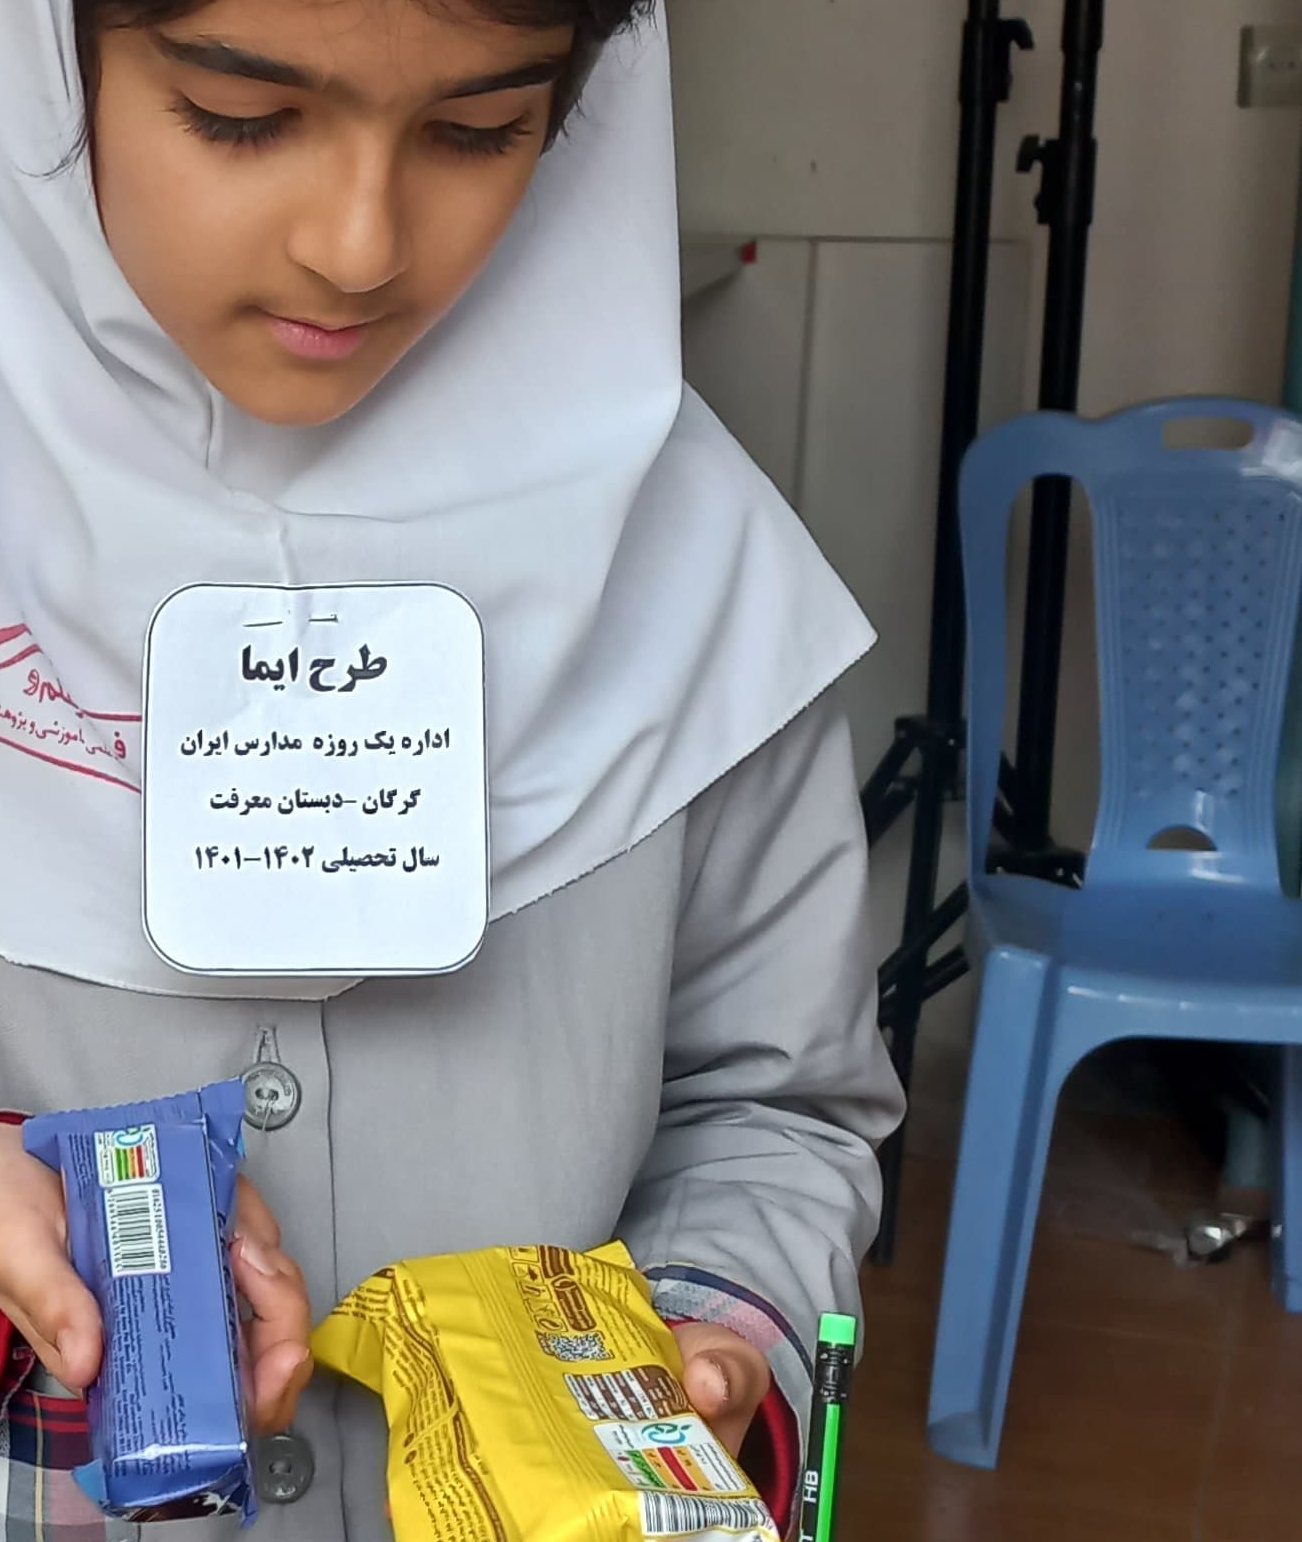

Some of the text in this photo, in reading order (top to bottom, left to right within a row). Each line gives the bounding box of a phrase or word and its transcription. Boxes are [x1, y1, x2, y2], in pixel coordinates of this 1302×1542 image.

[241, 643, 388, 692] طرح ایما
[180, 727, 450, 757] اداره یک روزه مدارس ایران
[209, 787, 272, 815] معرفت
[361, 788, 422, 815] گرگان
[320, 846, 397, 873] تحصیلی
[402, 845, 440, 873] سال
[803, 1470, 819, 1503] HB
